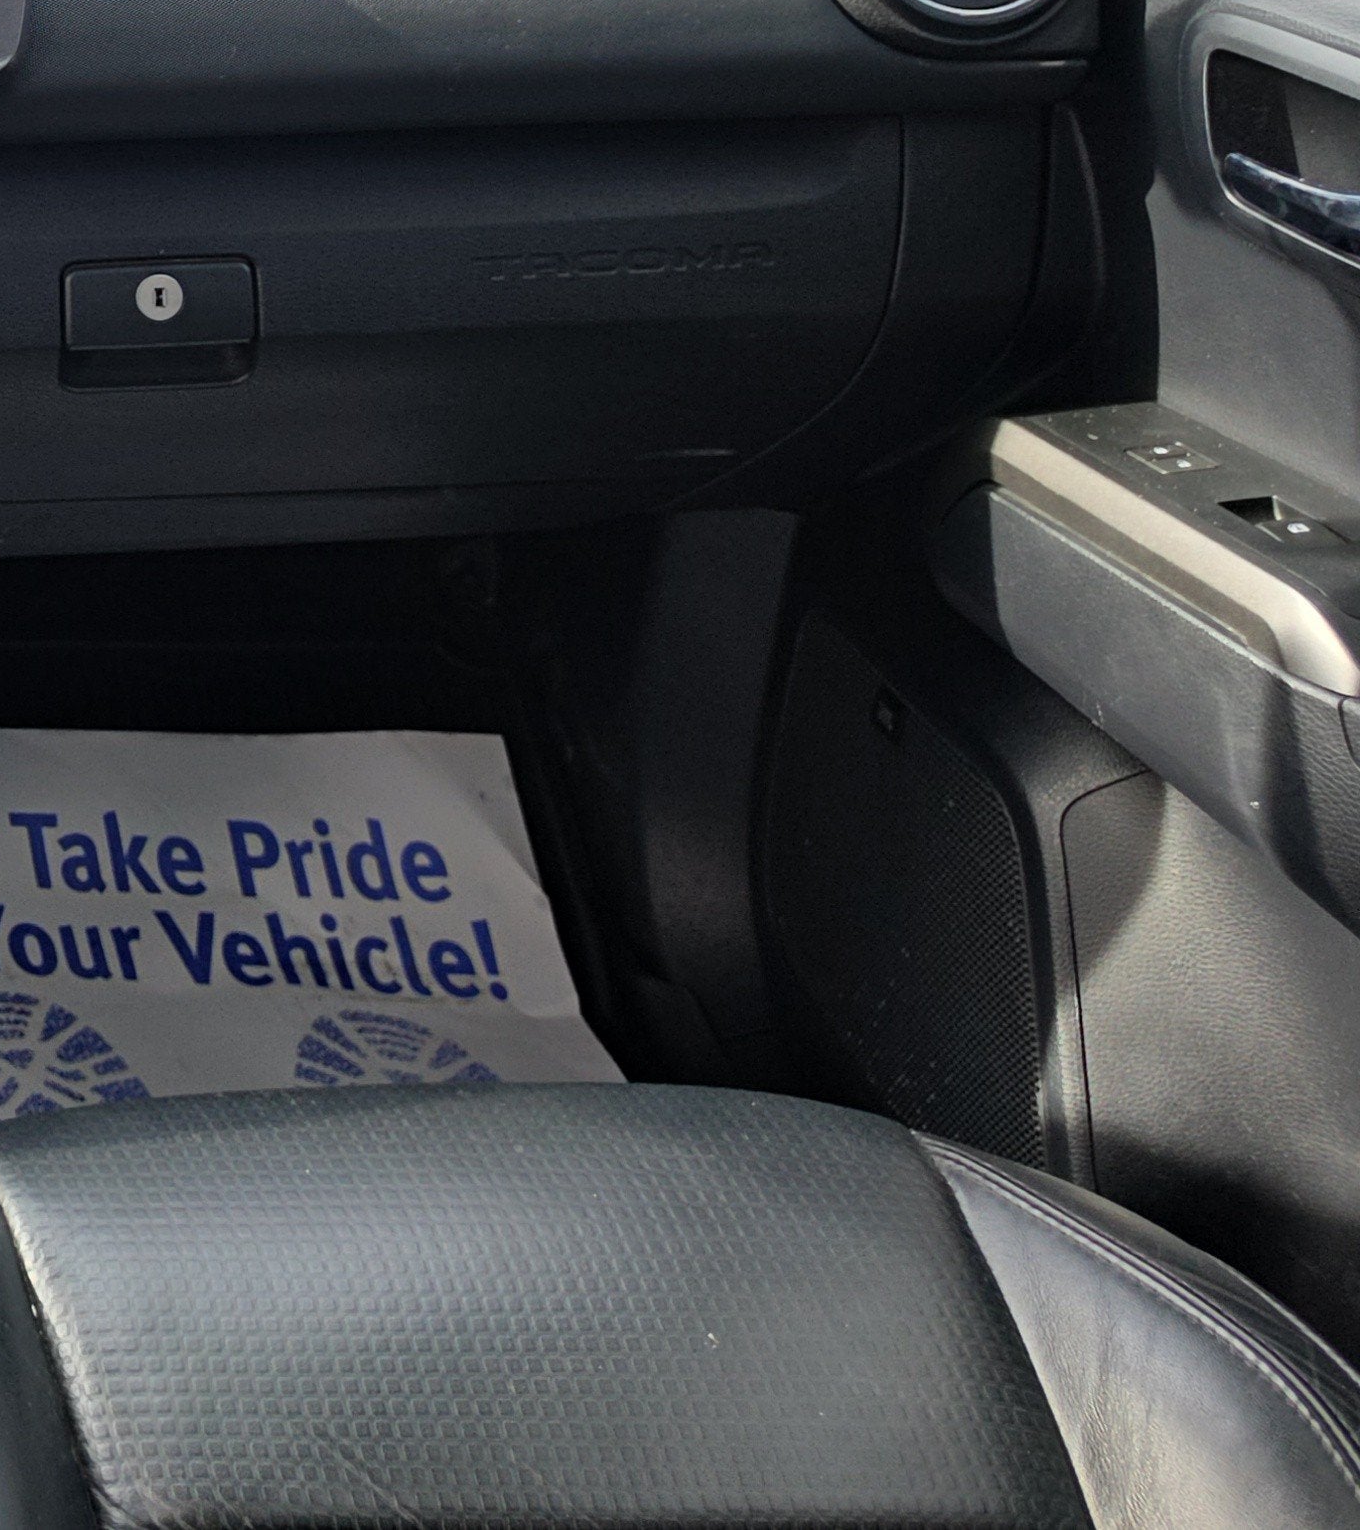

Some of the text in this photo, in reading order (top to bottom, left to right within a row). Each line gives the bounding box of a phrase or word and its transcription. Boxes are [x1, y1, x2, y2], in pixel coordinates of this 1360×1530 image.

[8, 811, 206, 898] Take
[227, 818, 453, 905] Pride
[154, 909, 509, 1003] Vehicle!
